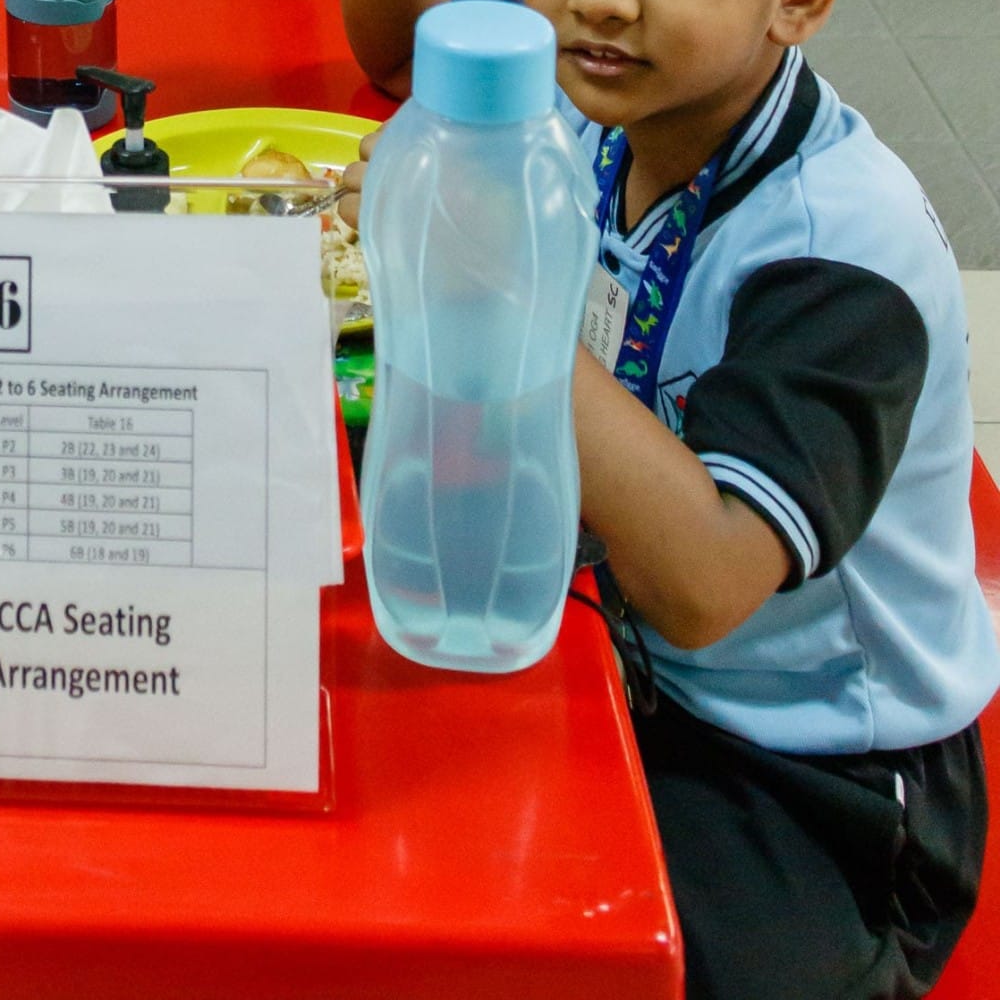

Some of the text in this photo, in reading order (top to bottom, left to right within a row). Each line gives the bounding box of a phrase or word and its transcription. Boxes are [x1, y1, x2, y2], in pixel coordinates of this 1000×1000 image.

[600, 306, 614, 357] HEART
[7, 381, 23, 396] to
[27, 380, 36, 396] 6
[40, 380, 96, 402] Seating
[100, 383, 199, 402] Arrangement
[88, 416, 134, 431] Table 16
[2, 440, 16, 453] P2
[118, 443, 139, 457] and
[2, 465, 16, 479] P3
[102, 469, 116, 482] 20
[118, 469, 139, 483] and
[2, 491, 16, 504] P4
[102, 495, 116, 508] 20
[118, 495, 139, 509] and
[2, 518, 16, 531] P5
[102, 521, 116, 534] 20
[118, 521, 139, 535] and
[108, 547, 129, 561] and
[63, 603, 171, 646] Seating
